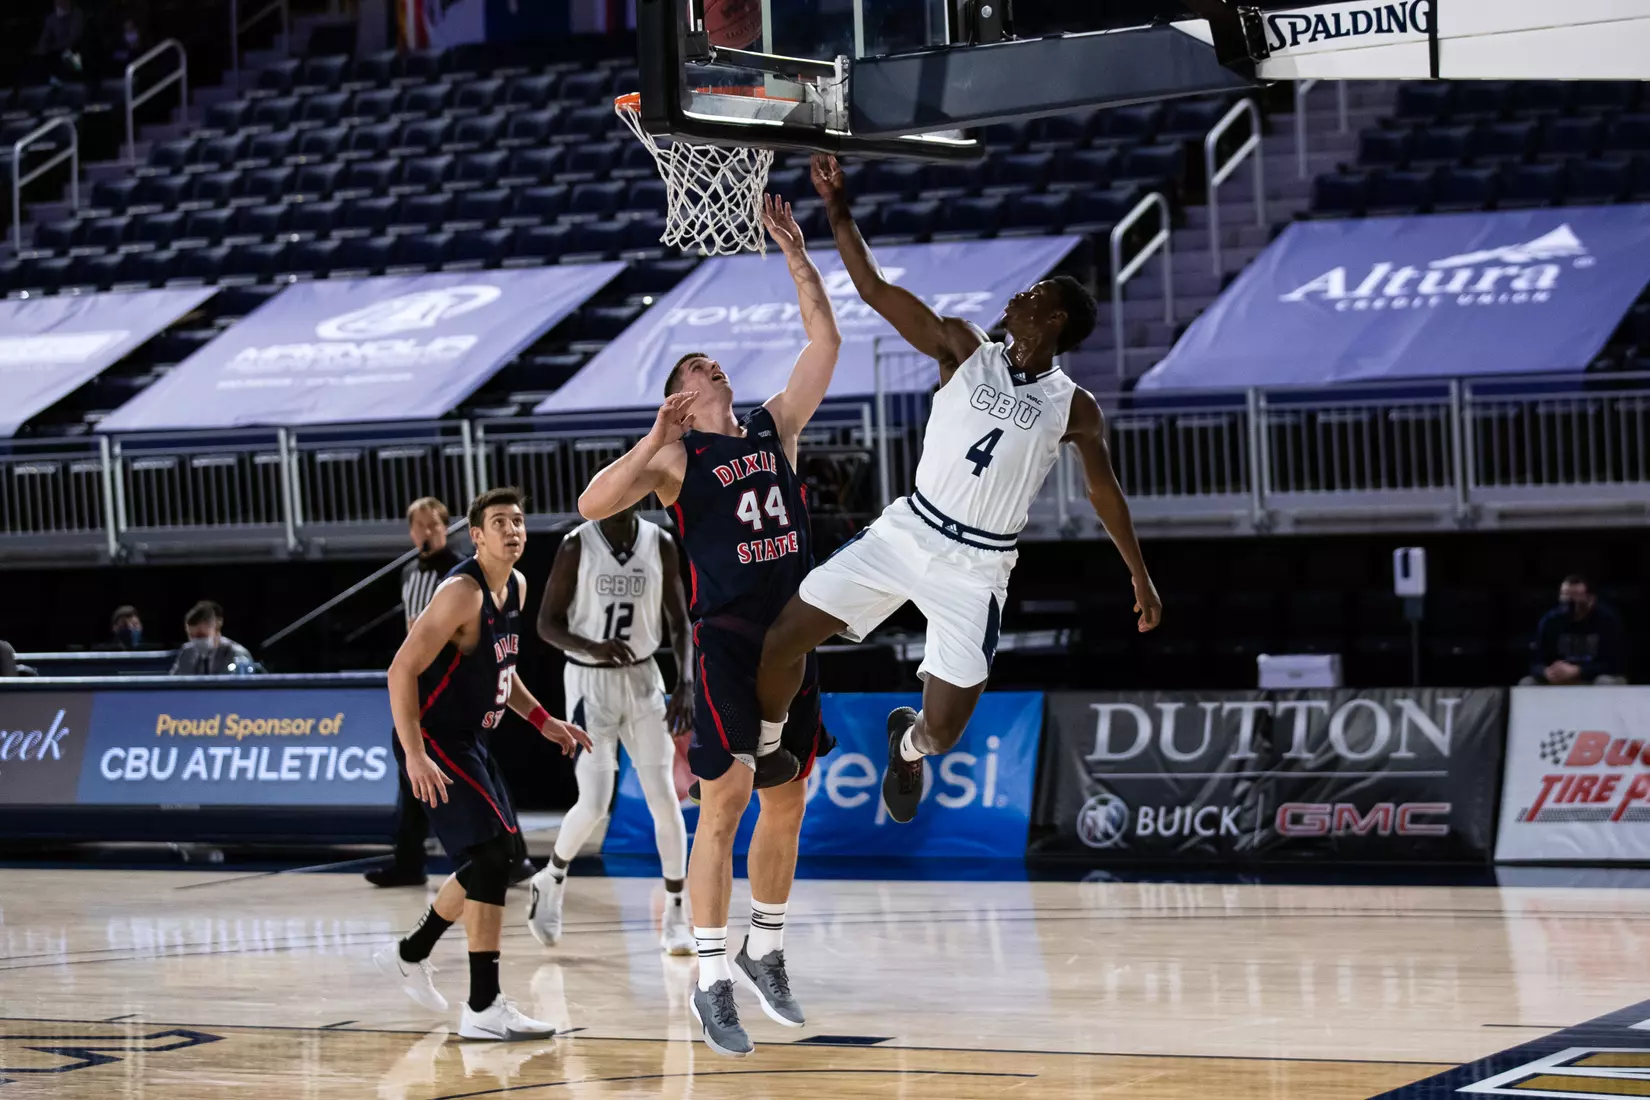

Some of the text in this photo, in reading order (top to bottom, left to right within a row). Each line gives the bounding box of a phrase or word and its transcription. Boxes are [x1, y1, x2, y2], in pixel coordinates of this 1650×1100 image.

[1267, 0, 1431, 50] SPALDING
[1280, 261, 1562, 301] Altura
[969, 383, 1041, 430] CBU
[965, 427, 1004, 477] 4
[734, 483, 791, 532] 44
[737, 531, 799, 564] STATE
[596, 574, 646, 597] CBU
[602, 602, 635, 641] 12
[0, 709, 69, 761] eek
[155, 713, 345, 740] Proud Sponsor of
[1084, 697, 1461, 763] DUTTON
[101, 746, 388, 781] CBU ATHLETICS
[1525, 773, 1625, 822] TIRE
[1135, 805, 1243, 838] BUICK
[1274, 803, 1452, 837] GMC
